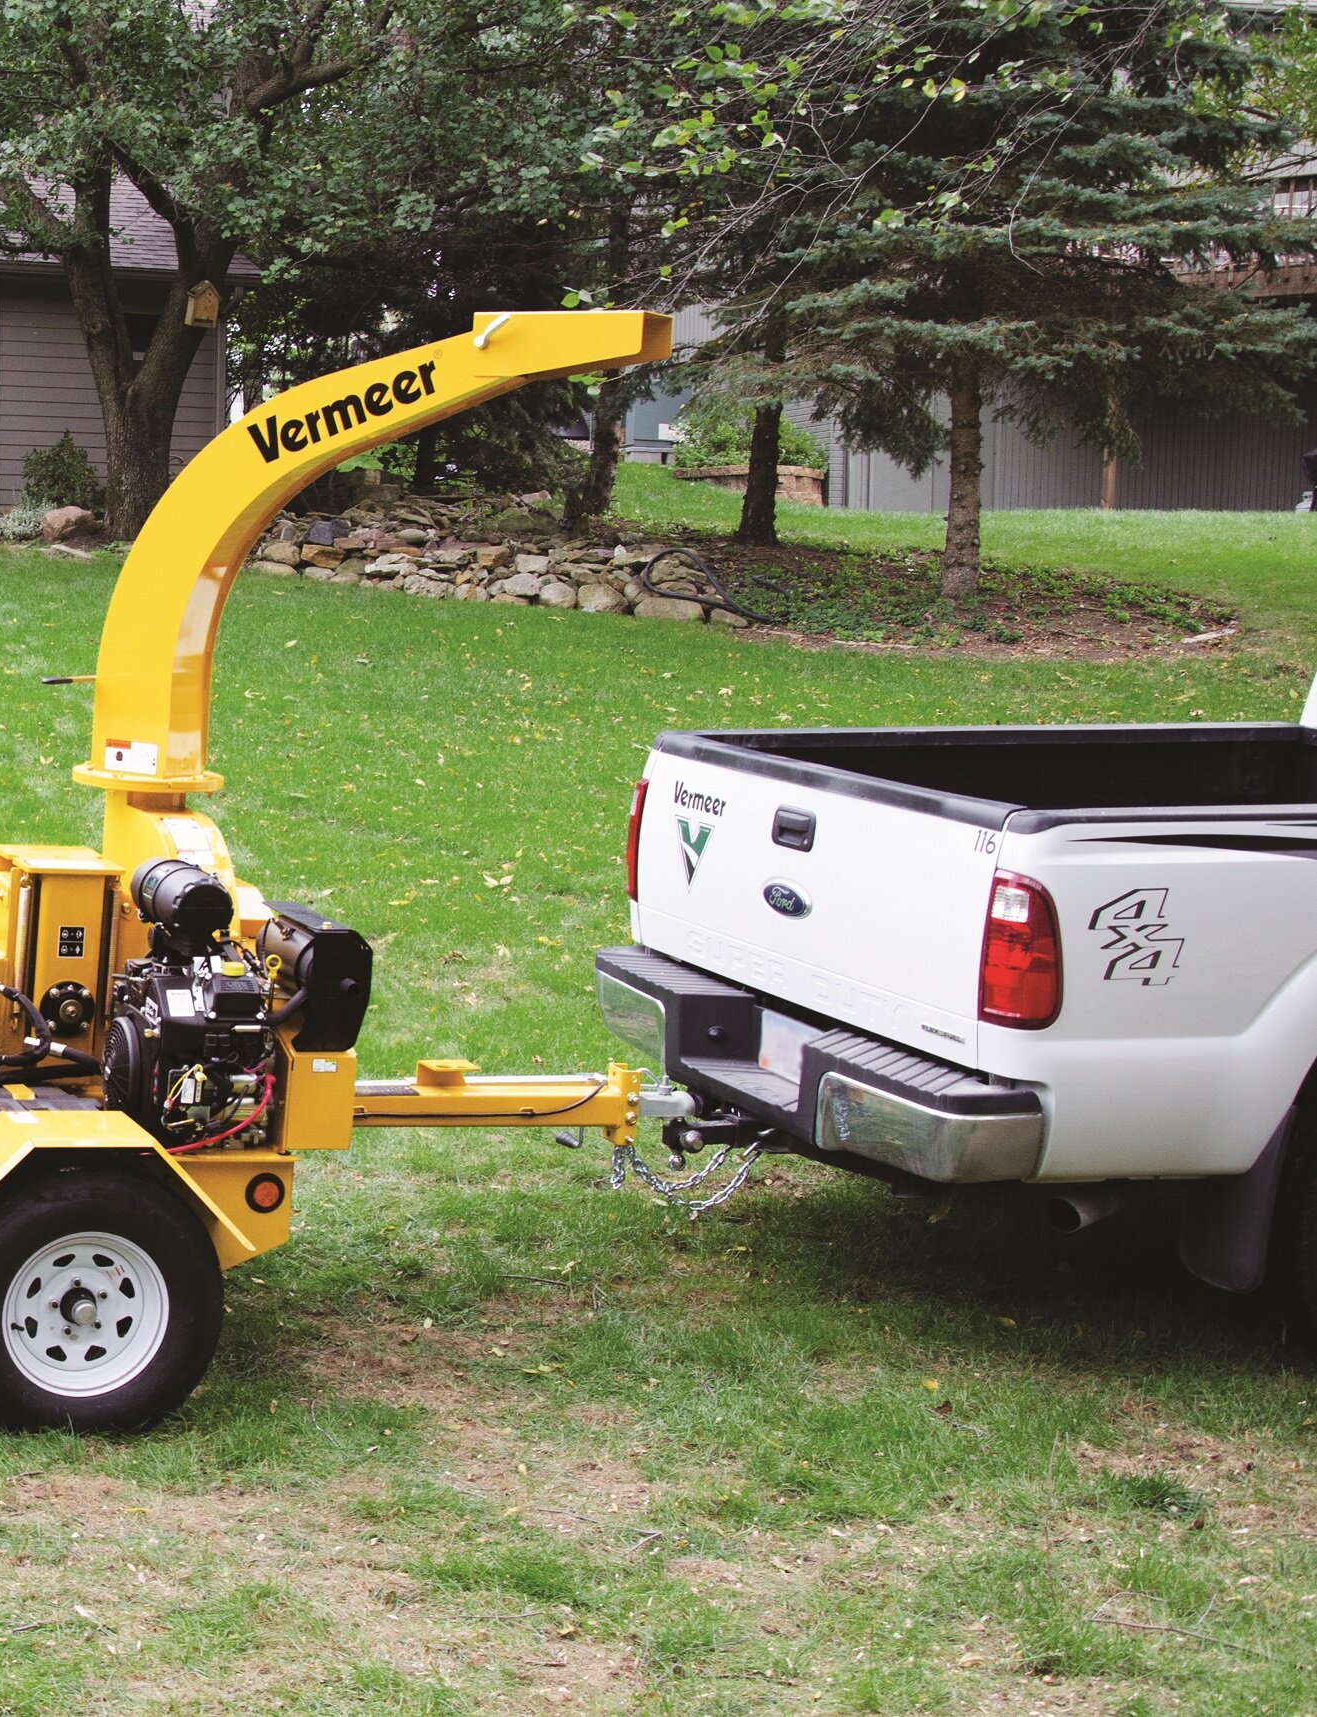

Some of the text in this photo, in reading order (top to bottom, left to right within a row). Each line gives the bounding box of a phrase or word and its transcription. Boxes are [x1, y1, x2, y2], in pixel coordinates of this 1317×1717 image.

[247, 360, 436, 463] Vermeer
[674, 780, 727, 816] Vermeer
[973, 829, 996, 854] 116
[768, 886, 795, 911] Ford
[687, 930, 905, 1030] SUPER DUTY
